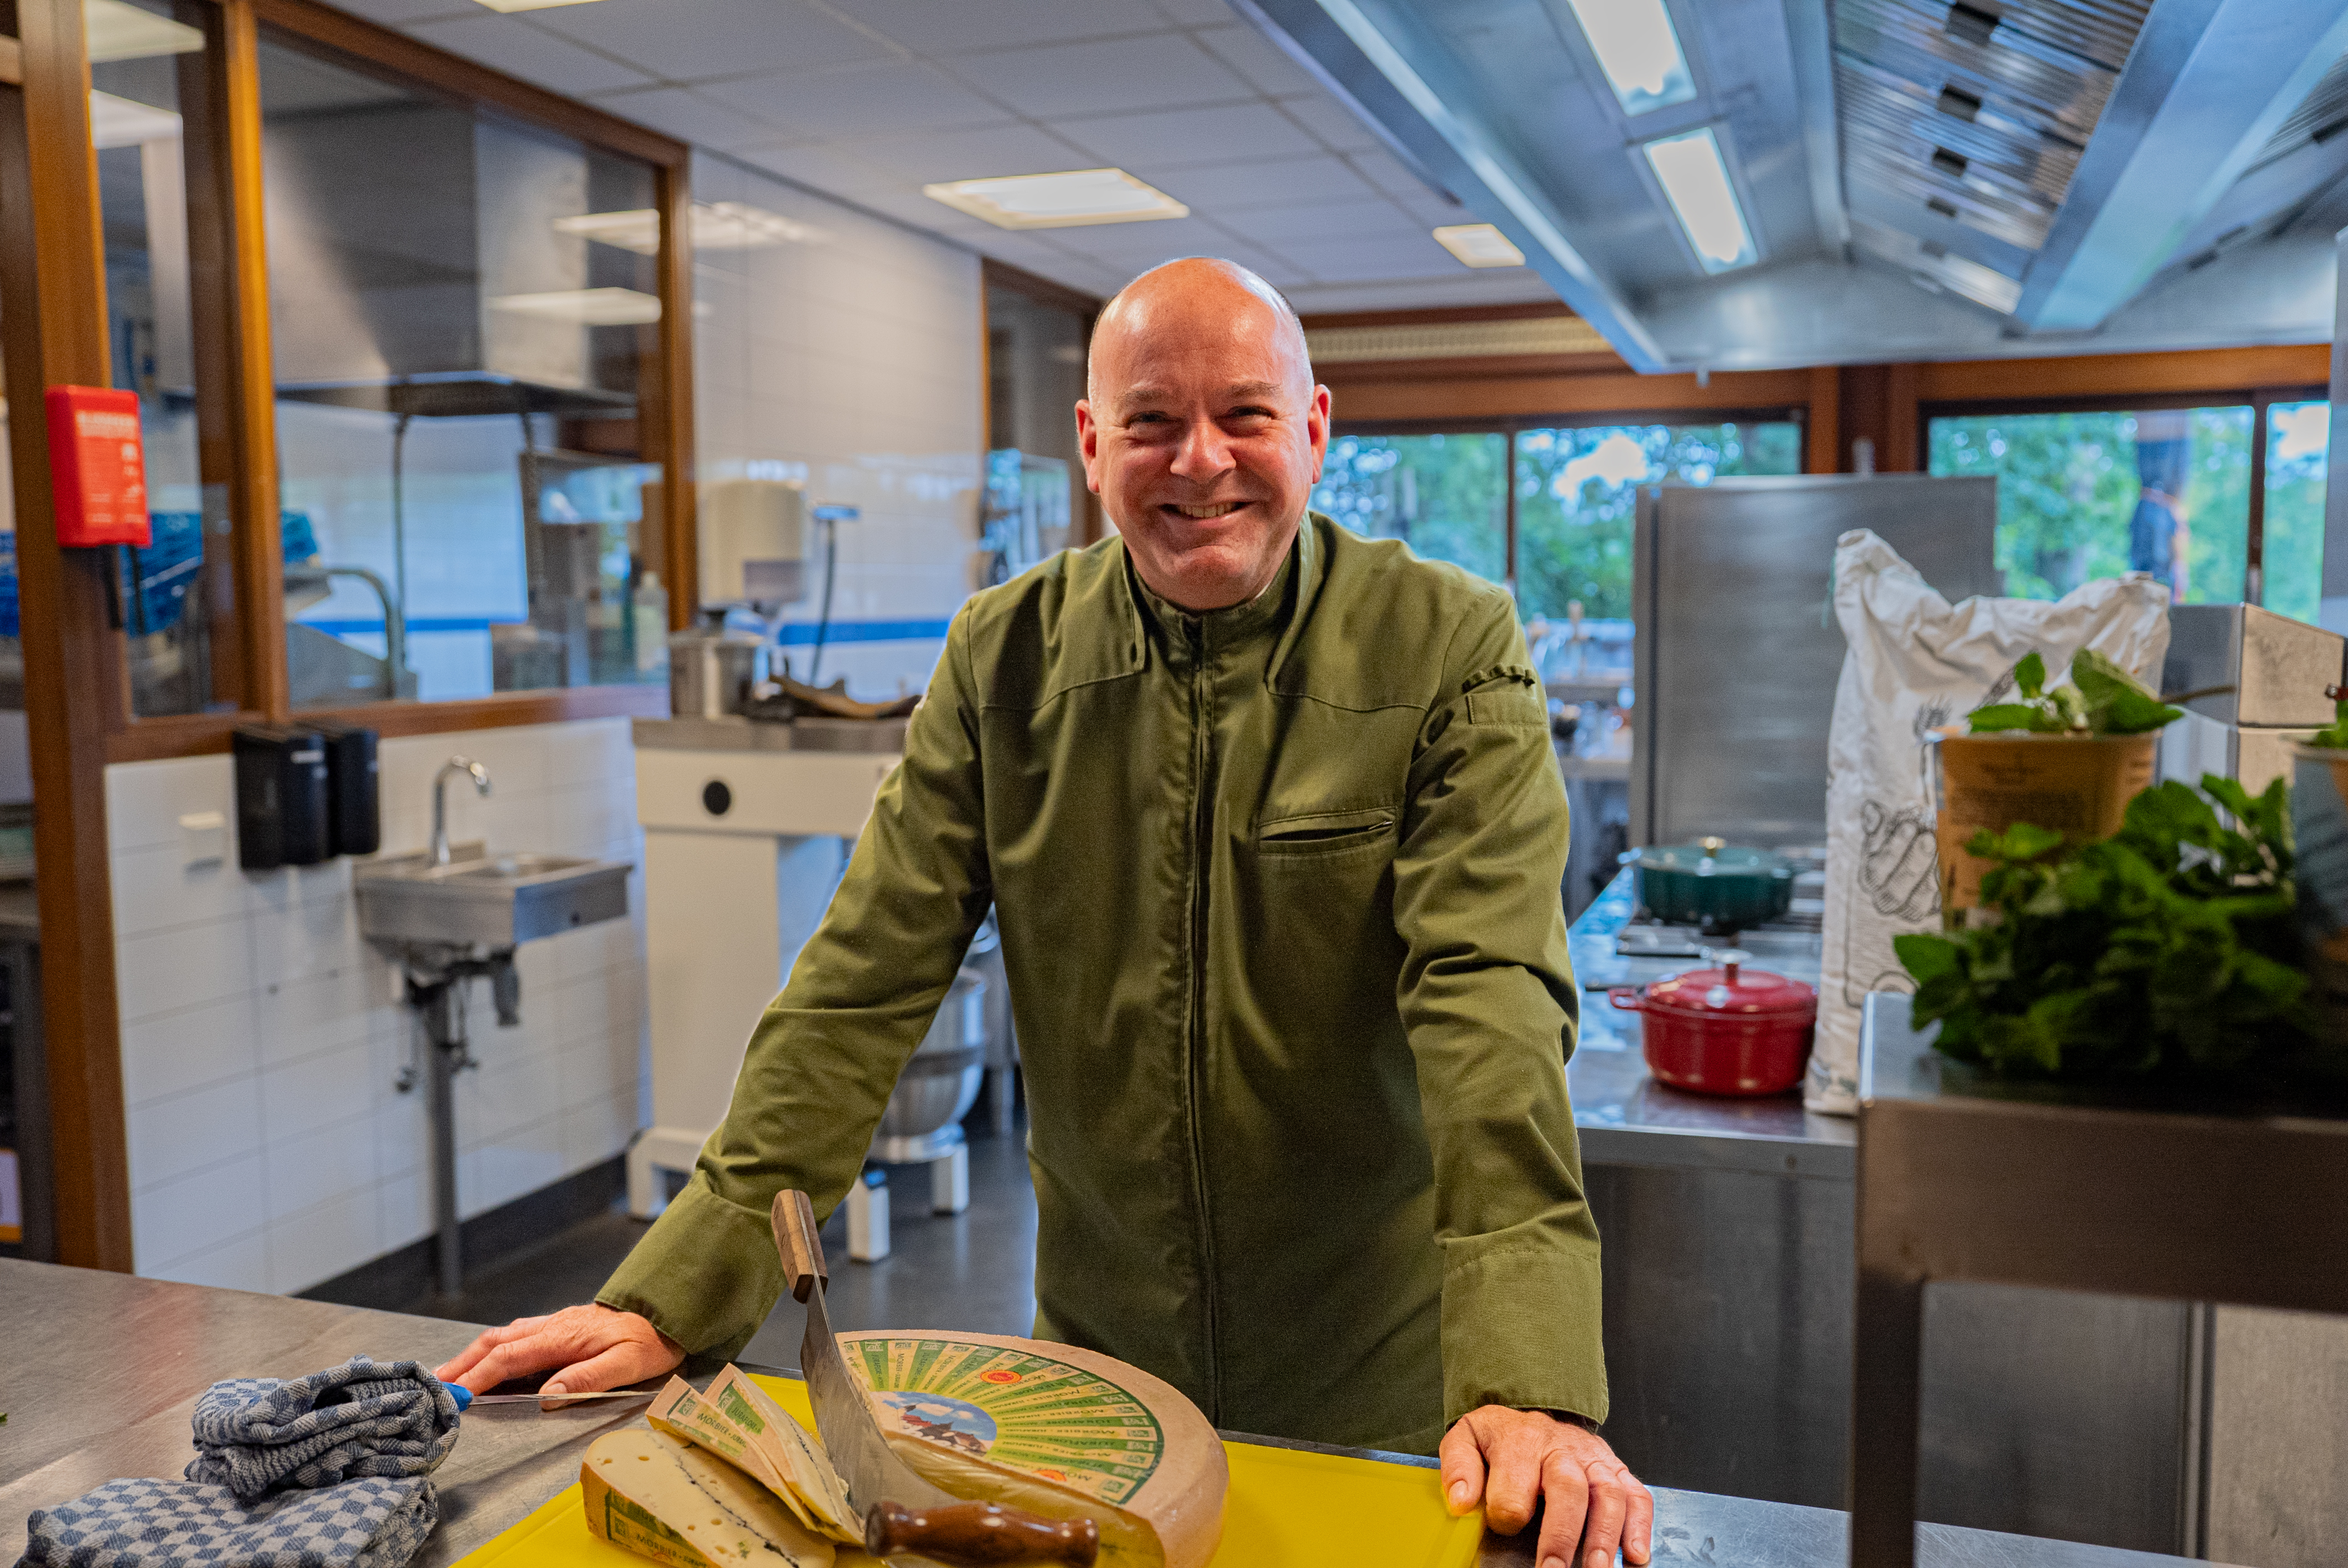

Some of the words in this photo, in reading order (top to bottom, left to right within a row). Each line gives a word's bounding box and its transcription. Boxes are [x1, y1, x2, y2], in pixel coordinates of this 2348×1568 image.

[895, 1353, 904, 1371] MORBIER
[1032, 1388, 1080, 1402] MORBIER
[697, 1412, 729, 1435] MORBIER
[732, 1407, 756, 1429] JURAFLORE
